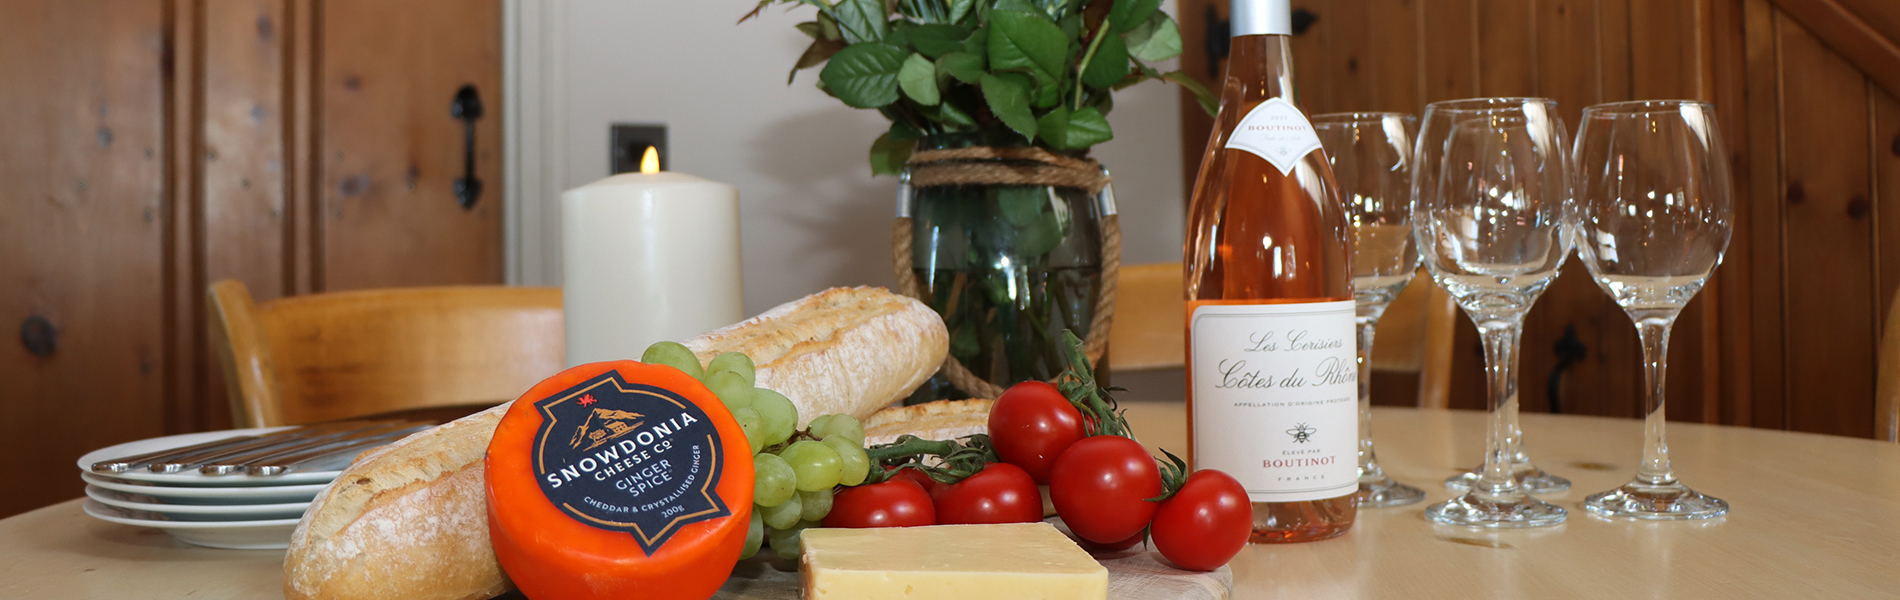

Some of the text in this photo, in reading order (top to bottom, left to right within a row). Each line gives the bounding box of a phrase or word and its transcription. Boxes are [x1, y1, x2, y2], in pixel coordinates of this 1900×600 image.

[1244, 329, 1344, 352] Les Cerisiers
[1215, 356, 1356, 389] Côtes du Rhôn
[1288, 399, 1324, 407] D'ORIGINE
[547, 411, 698, 488] SNOWDONIA
[1262, 455, 1337, 469] BOUTINOT
[583, 444, 701, 513] CHEDDAR & CRYSTALLISED GINGER
[594, 450, 651, 481] CHEESE
[615, 458, 672, 490] GINGER
[1277, 474, 1326, 482] FRANCE
[629, 471, 673, 497] SPICE
[661, 504, 685, 519] 200g
